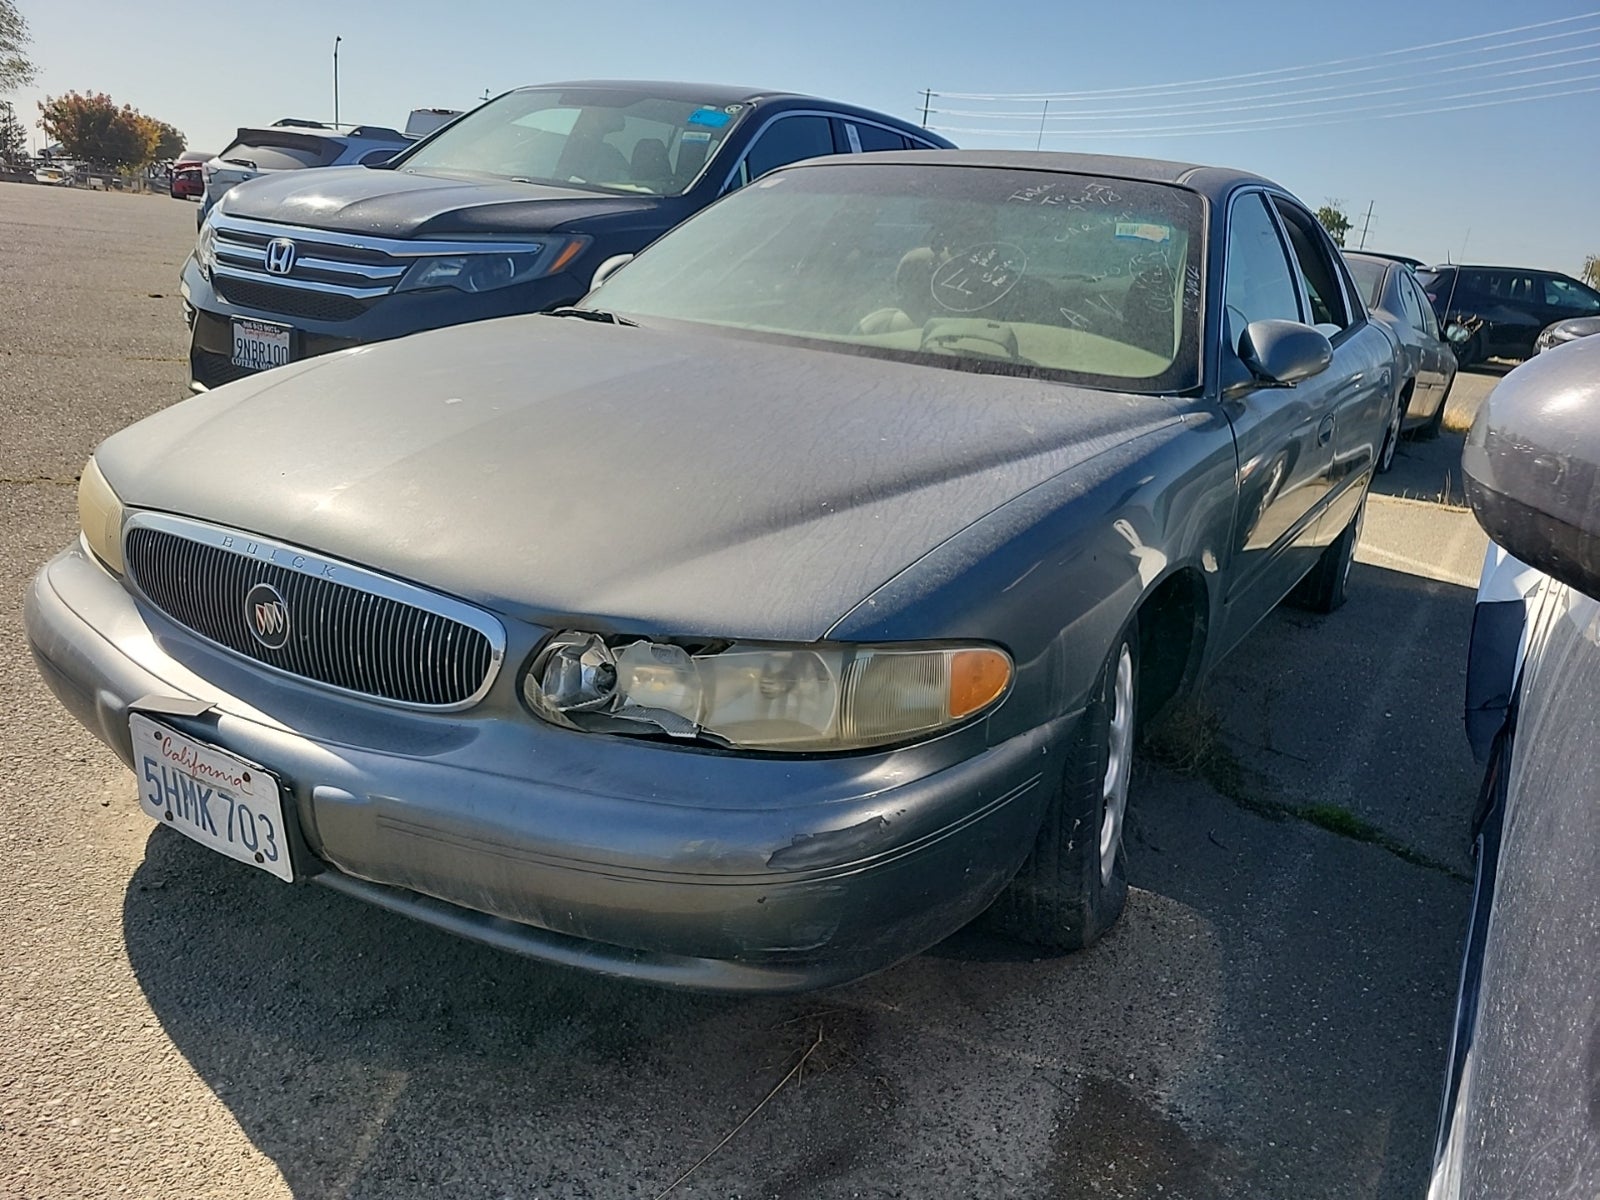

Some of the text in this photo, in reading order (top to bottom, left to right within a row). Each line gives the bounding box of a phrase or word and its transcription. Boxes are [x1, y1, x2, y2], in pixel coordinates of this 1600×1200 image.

[236, 337, 288, 366] 9NBR100
[222, 535, 336, 579] BUICK
[162, 736, 254, 796] California
[143, 755, 278, 862] 5HMK703
